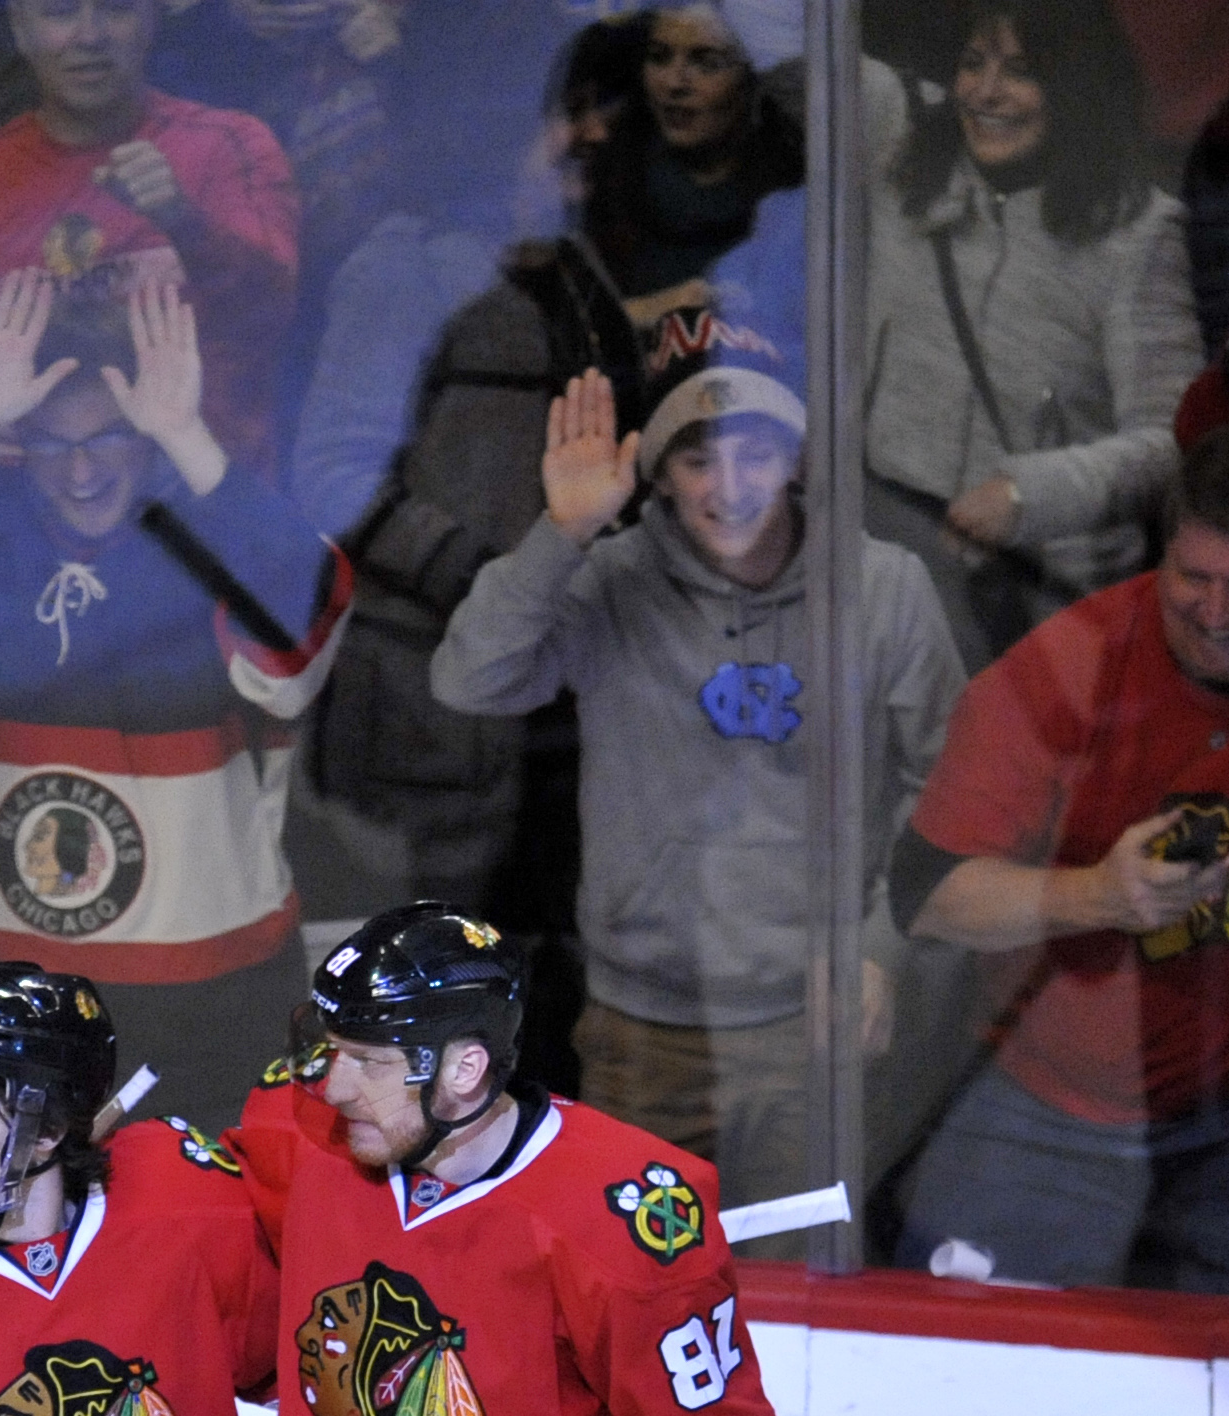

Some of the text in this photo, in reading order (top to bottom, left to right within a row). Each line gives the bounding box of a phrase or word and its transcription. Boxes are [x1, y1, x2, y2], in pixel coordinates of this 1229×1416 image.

[6, 882, 119, 933] CHICAGO
[325, 946, 363, 978] 81
[658, 1294, 742, 1411] 81
